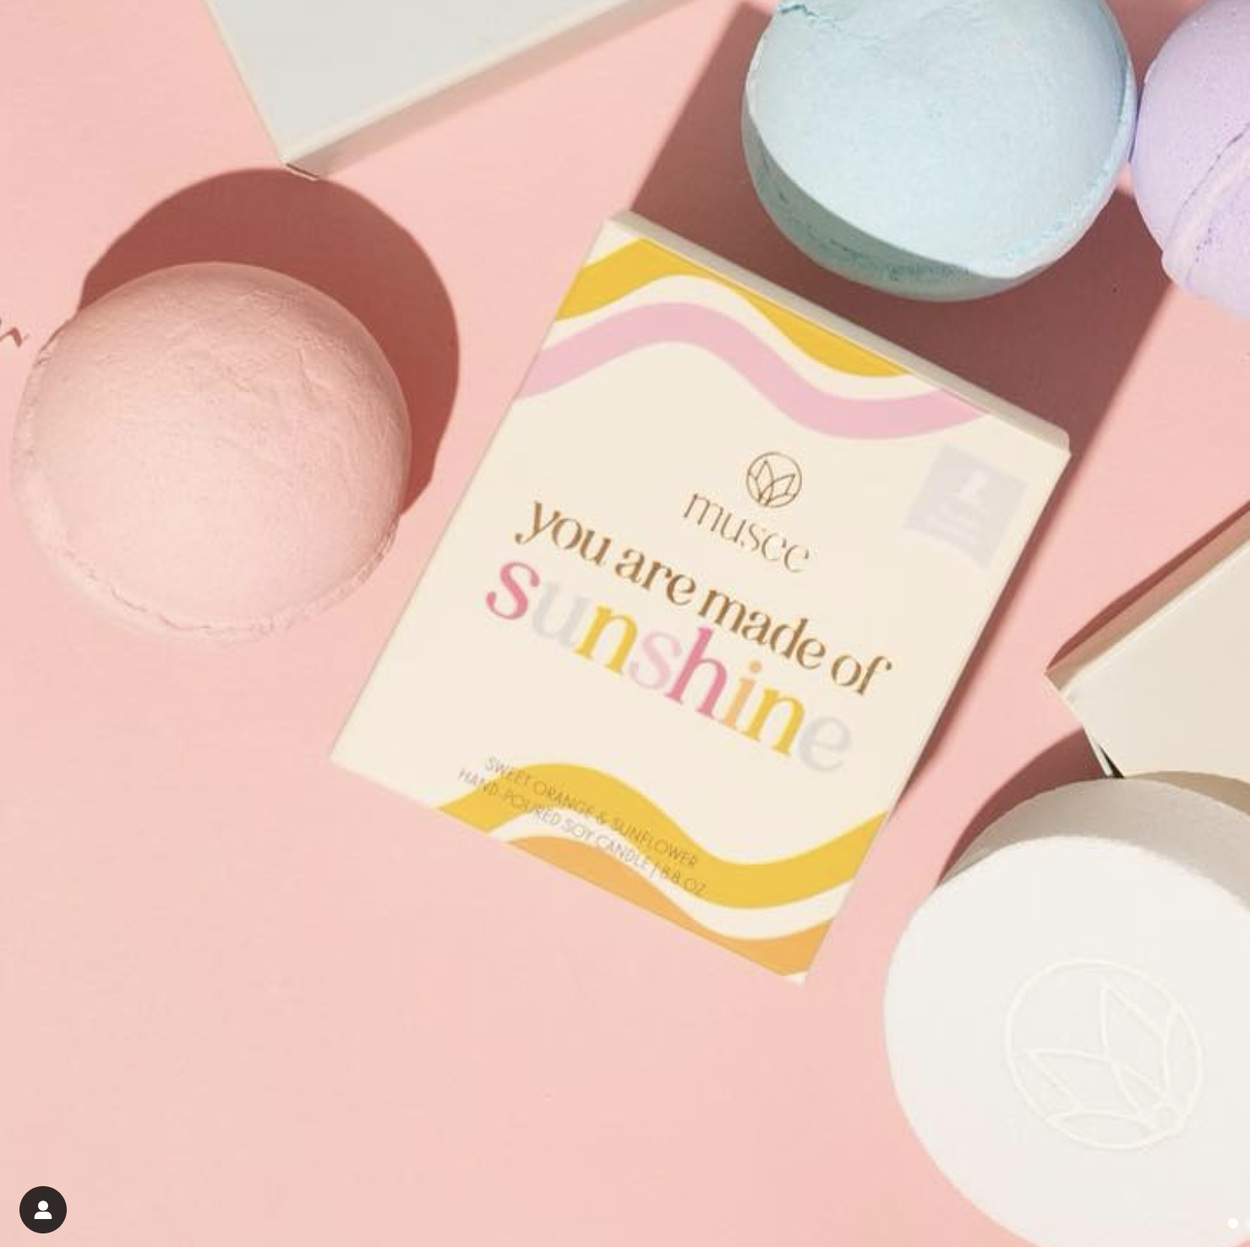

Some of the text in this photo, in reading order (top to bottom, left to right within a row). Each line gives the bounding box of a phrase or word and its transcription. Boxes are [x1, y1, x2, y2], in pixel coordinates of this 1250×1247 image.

[682, 492, 811, 574] musee
[513, 500, 893, 697] you are made of
[484, 560, 853, 774] sunshine
[485, 757, 531, 787] SWEET
[533, 779, 597, 819] ORANGE
[611, 817, 697, 869] SUNFLOWER
[563, 818, 595, 843] SOY
[595, 834, 650, 871] CANDLE
